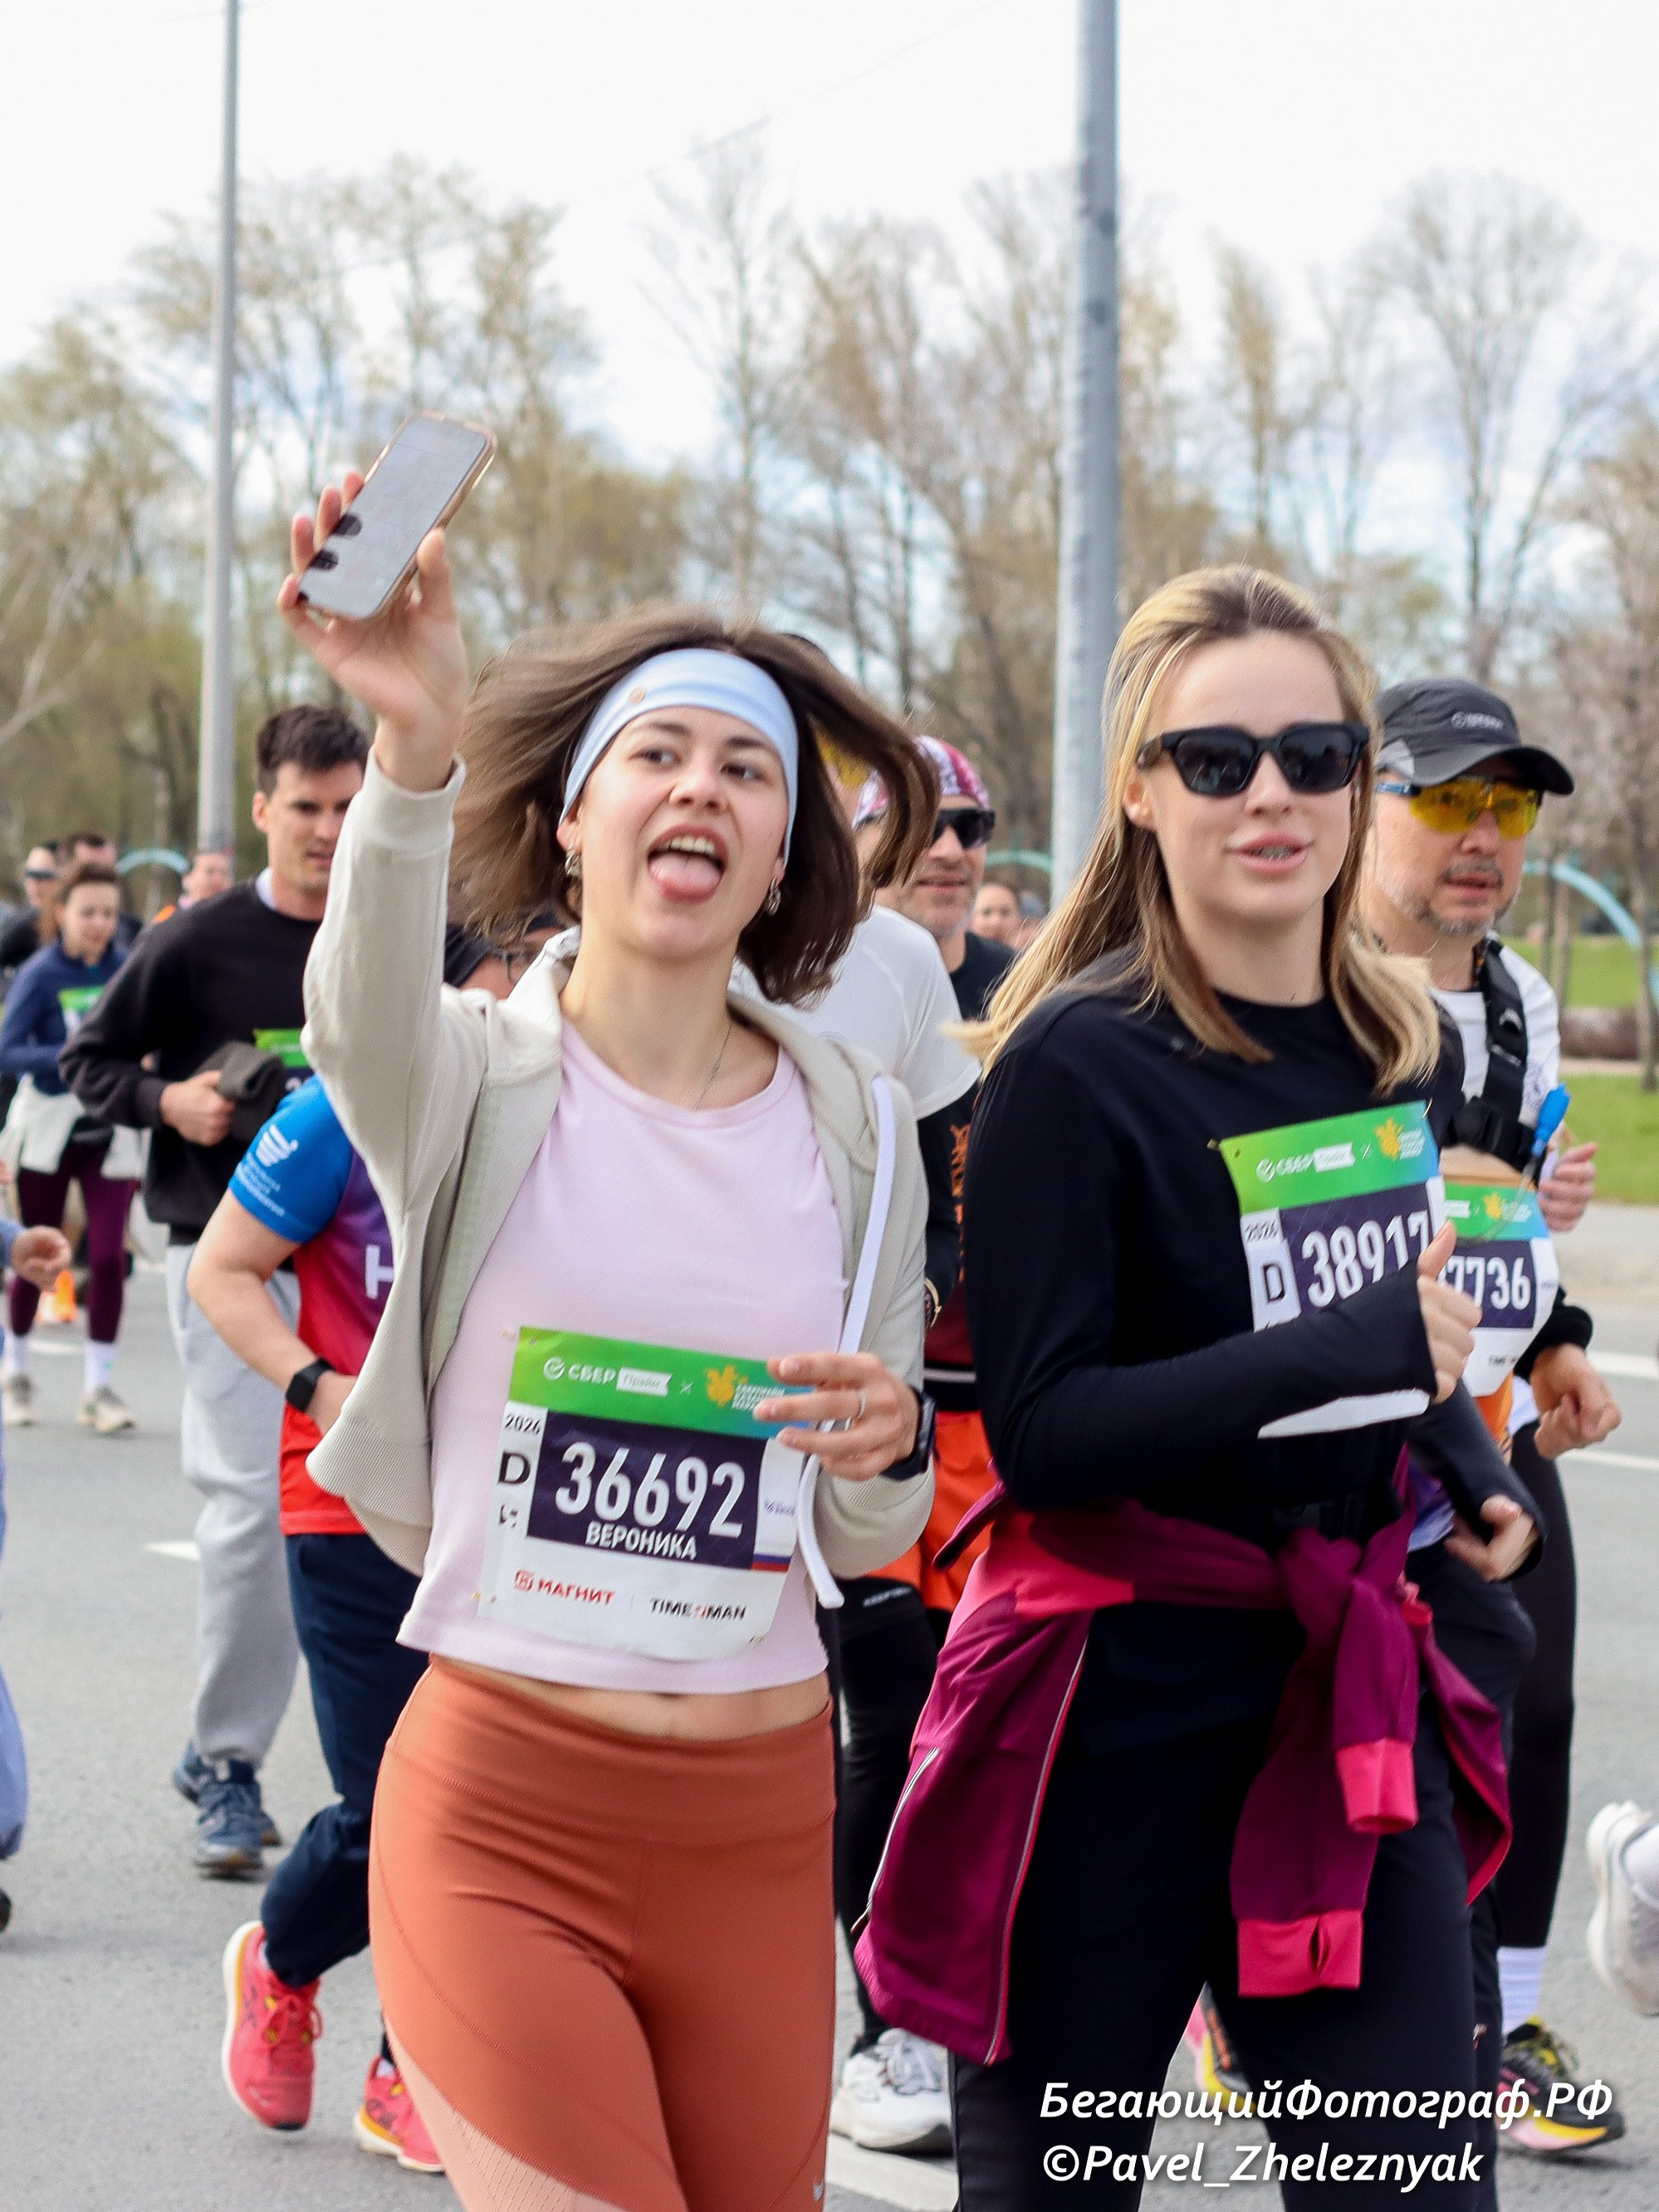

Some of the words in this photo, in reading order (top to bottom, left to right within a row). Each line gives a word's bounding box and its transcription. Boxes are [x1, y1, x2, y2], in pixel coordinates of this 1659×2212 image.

[1301, 1209, 1429, 1308] 38917
[1261, 1261, 1286, 1304] D
[1437, 1255, 1531, 1310] 7736
[567, 1363, 617, 1385] СБЕР
[504, 1413, 541, 1435] 2026
[497, 1451, 531, 1485] D
[555, 1441, 746, 1539] 36692
[585, 1520, 697, 1561] ВЕРОНИКА
[536, 1577, 616, 1607] МАГНИТ
